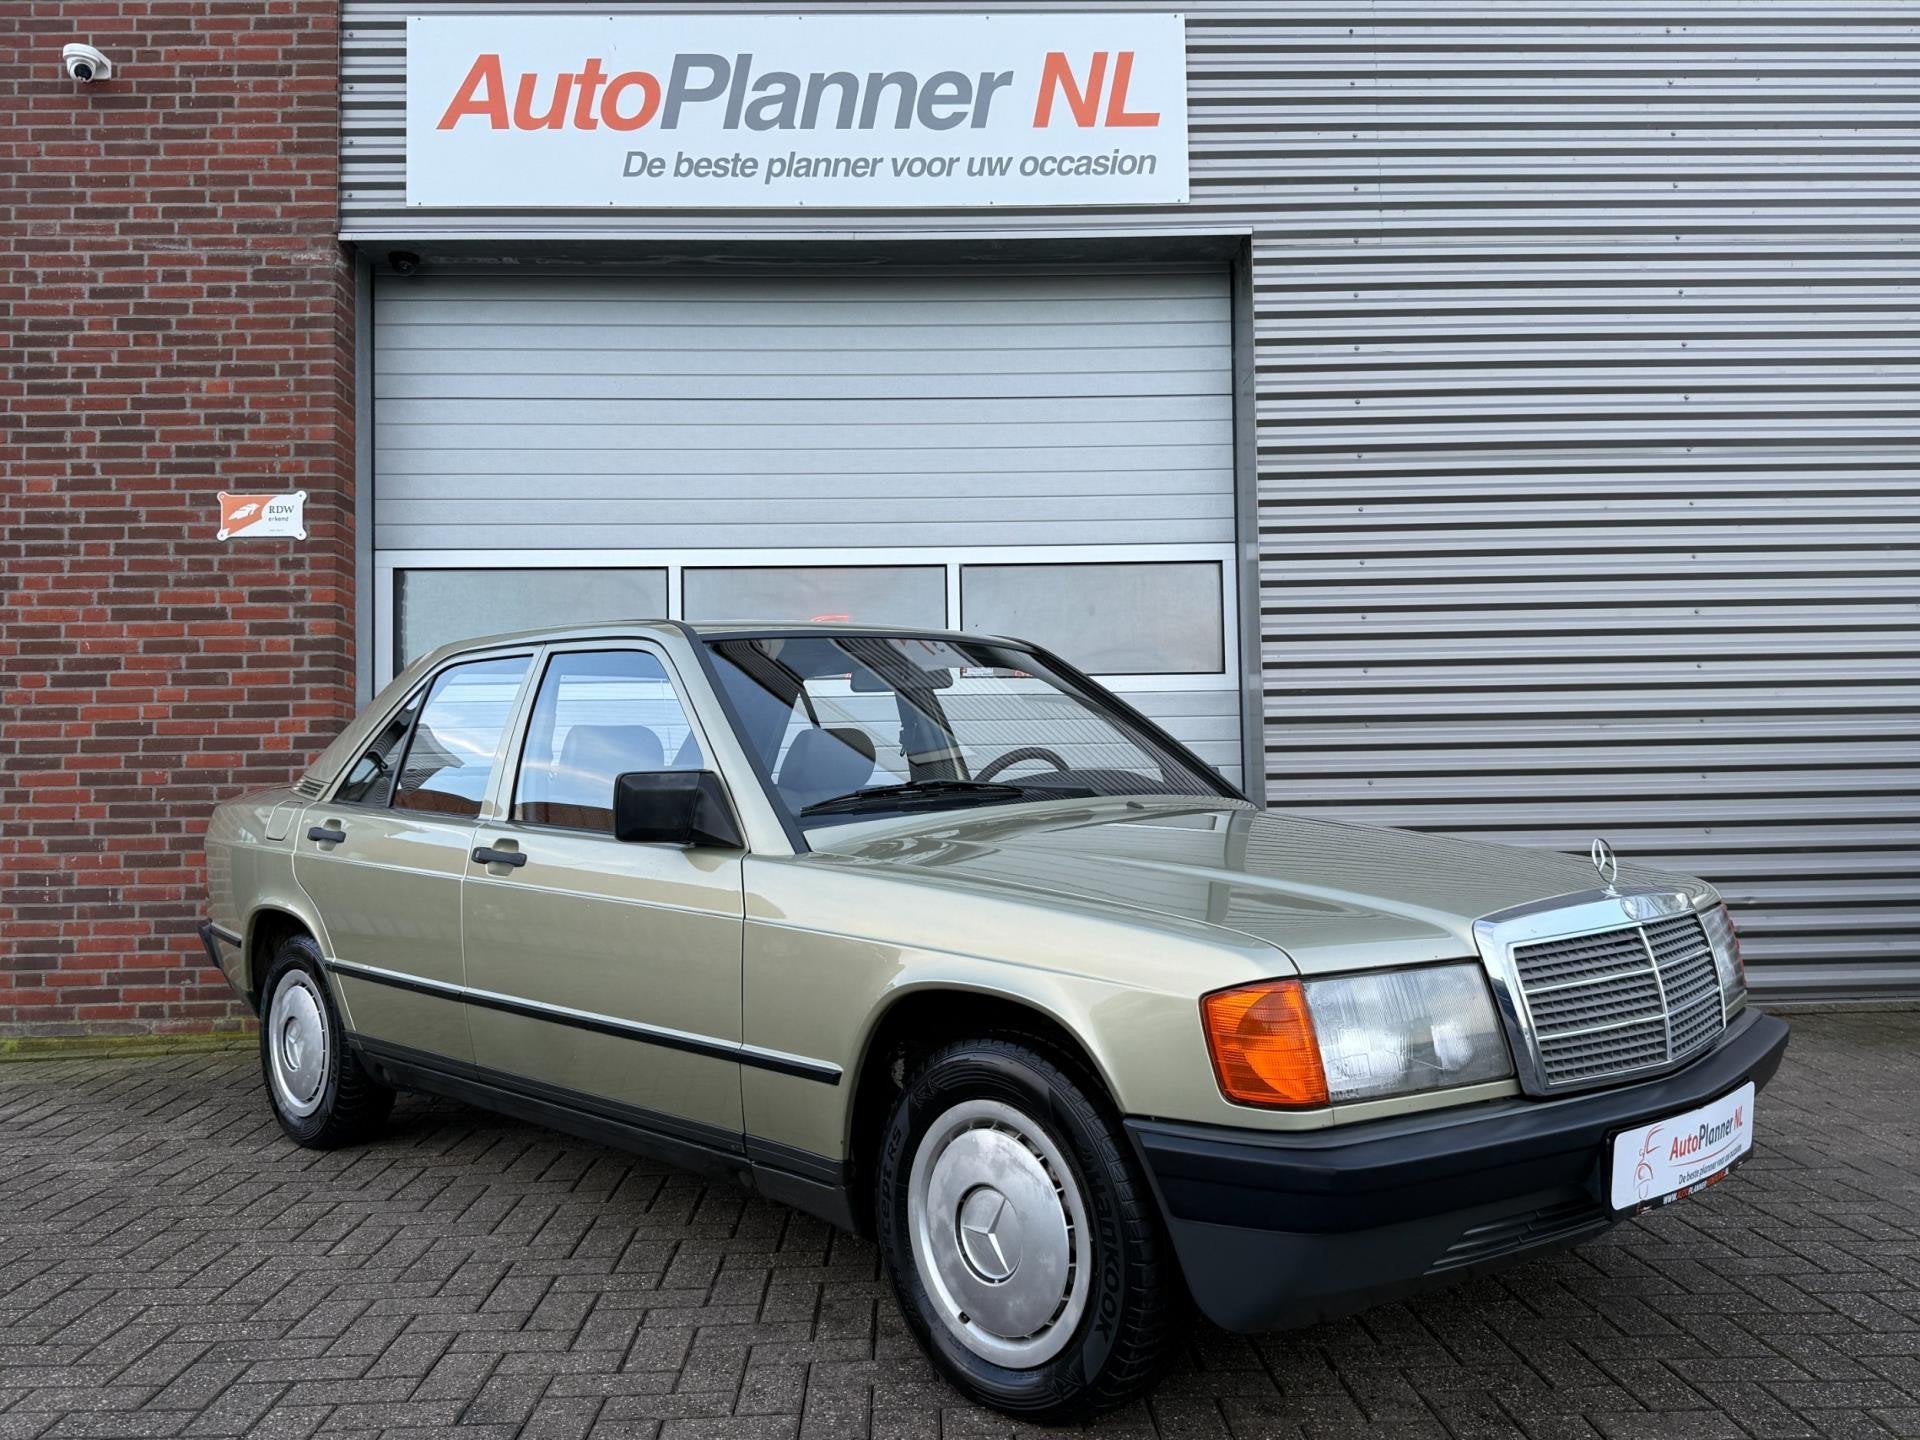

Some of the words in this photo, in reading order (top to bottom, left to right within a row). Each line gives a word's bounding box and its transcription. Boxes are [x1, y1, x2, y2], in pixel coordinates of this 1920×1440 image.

[436, 53, 1014, 131] AutoPlanner
[1032, 51, 1160, 128] NL
[623, 151, 665, 177] De
[674, 152, 758, 177] beste
[765, 152, 884, 184] planner
[892, 157, 960, 177] voor
[967, 157, 1013, 177] uw
[1020, 149, 1156, 177] occasion
[268, 505, 294, 514] RDW
[1669, 1117, 1733, 1160] AutoPlanner
[1734, 1105, 1743, 1130] NL
